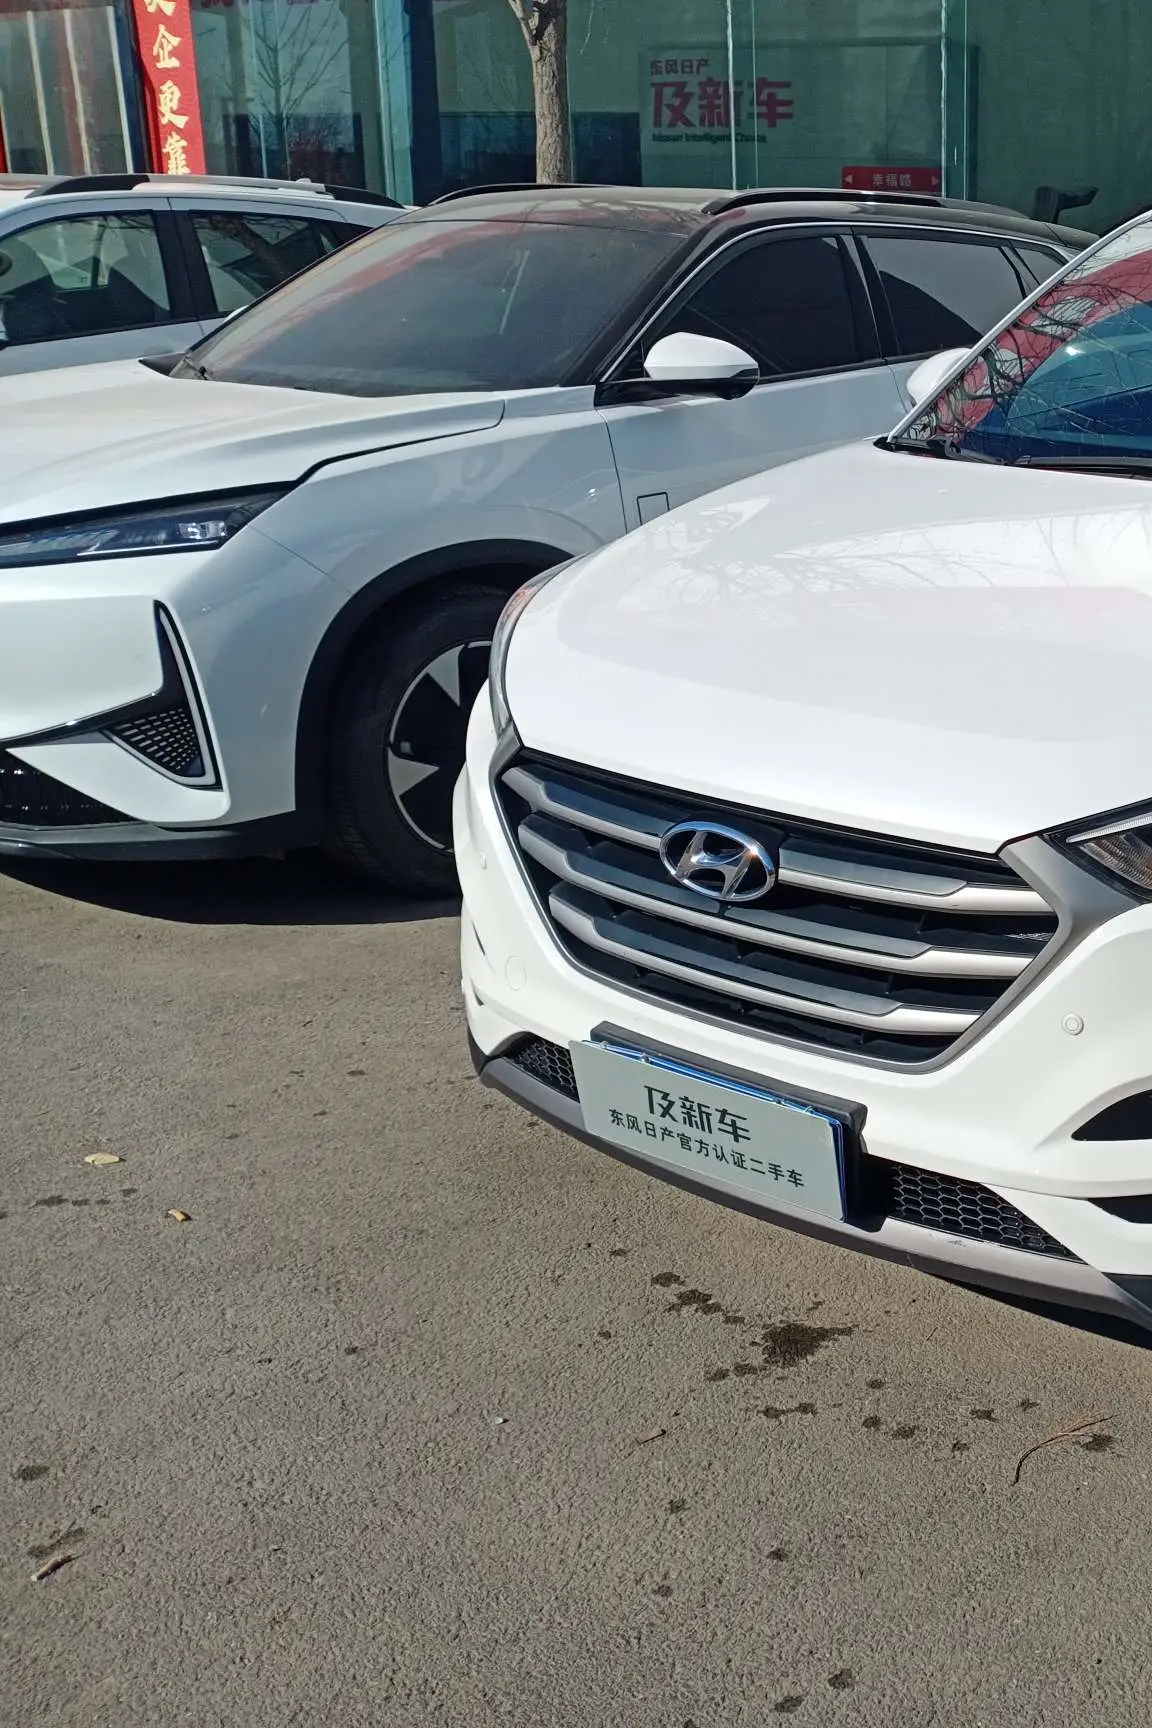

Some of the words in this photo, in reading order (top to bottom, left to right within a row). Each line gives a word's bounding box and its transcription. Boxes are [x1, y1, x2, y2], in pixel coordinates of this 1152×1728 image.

[650, 58, 710, 76] 东风日产
[650, 77, 795, 128] 及新车
[871, 173, 912, 188] 幸福路
[644, 1085, 751, 1143] 及新车
[608, 1108, 805, 1188] 东风日产官方认证二手车
